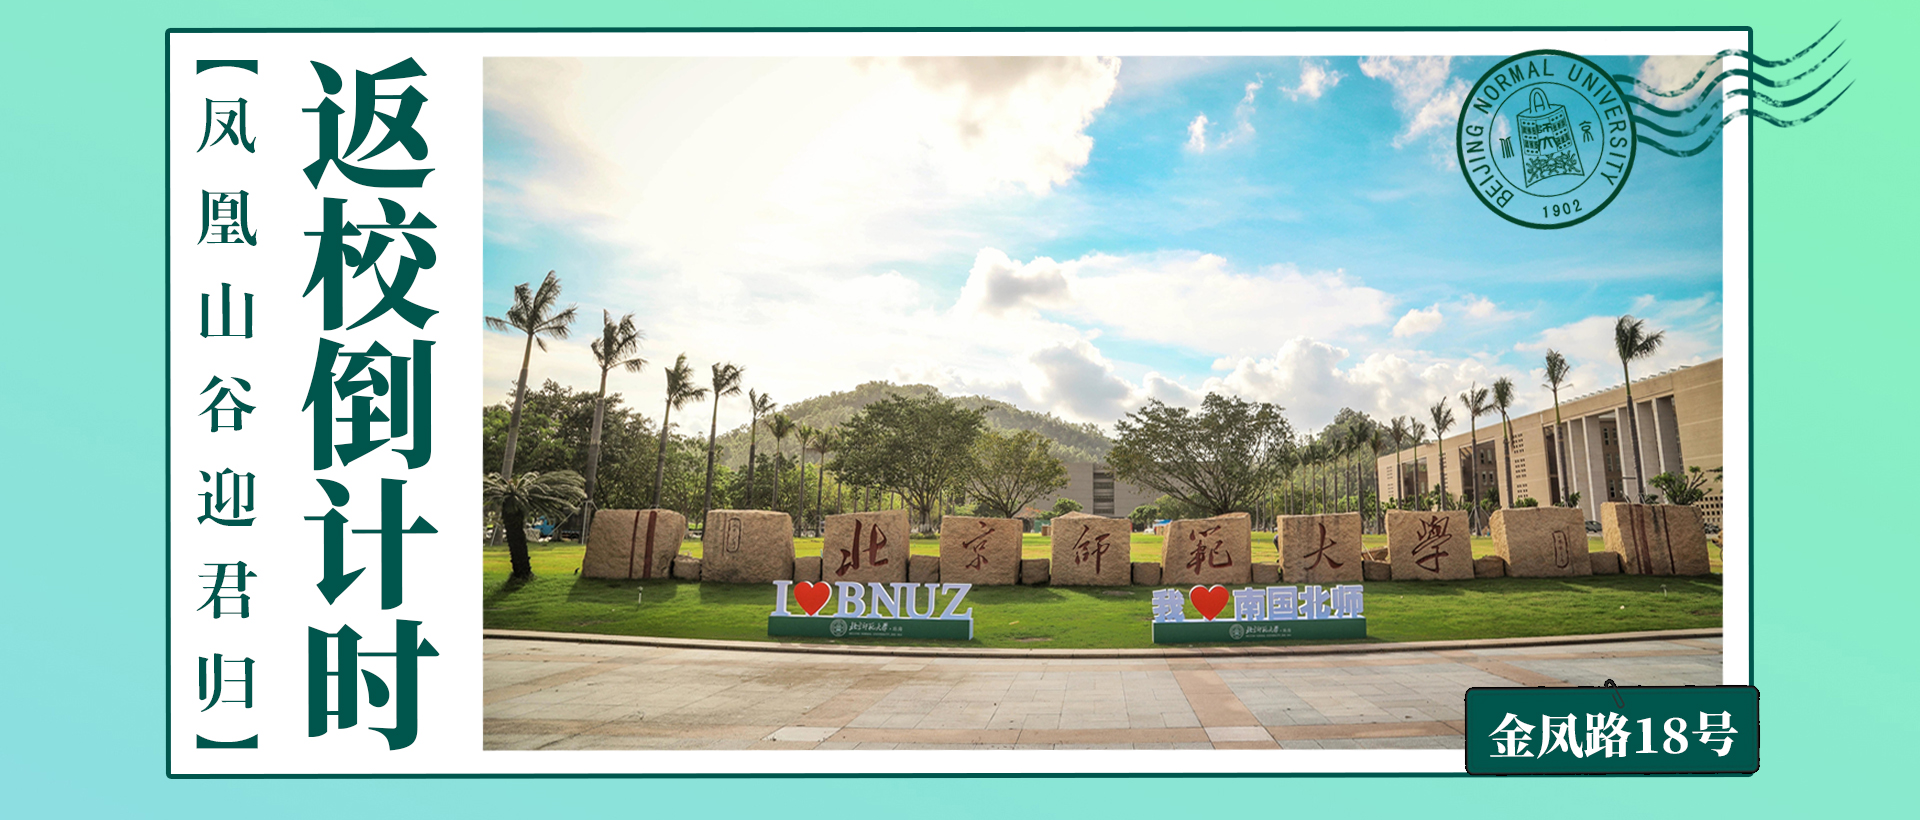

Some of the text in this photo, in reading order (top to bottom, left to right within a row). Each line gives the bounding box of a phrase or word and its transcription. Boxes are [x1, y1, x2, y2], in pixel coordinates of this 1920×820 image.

[771, 580, 974, 620] I BNUZ
[1232, 583, 1364, 621] 南国北师
